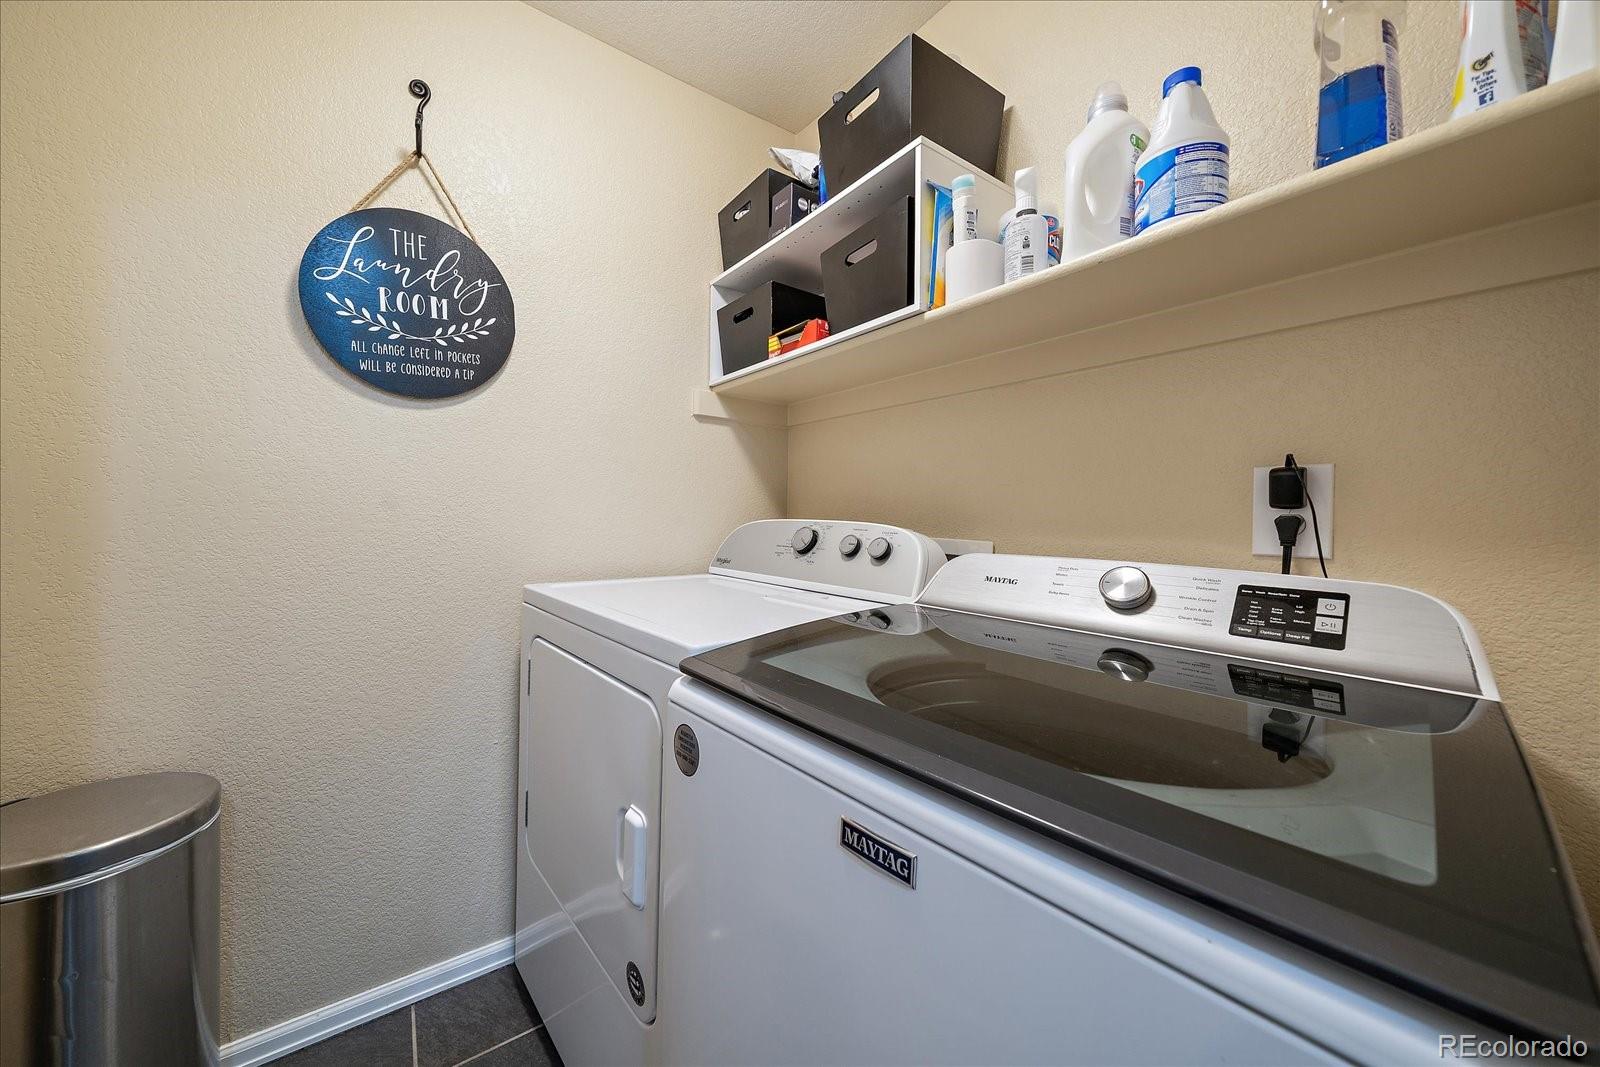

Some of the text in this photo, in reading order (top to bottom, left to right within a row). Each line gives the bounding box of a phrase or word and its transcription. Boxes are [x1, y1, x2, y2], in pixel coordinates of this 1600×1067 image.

[389, 228, 427, 260] THE
[313, 226, 501, 316] Laundry
[377, 287, 449, 320] ROOM
[351, 340, 368, 352] ALL
[454, 368, 460, 379] A
[984, 575, 1018, 586] MAYTAG
[844, 826, 910, 878] MAYTAG
